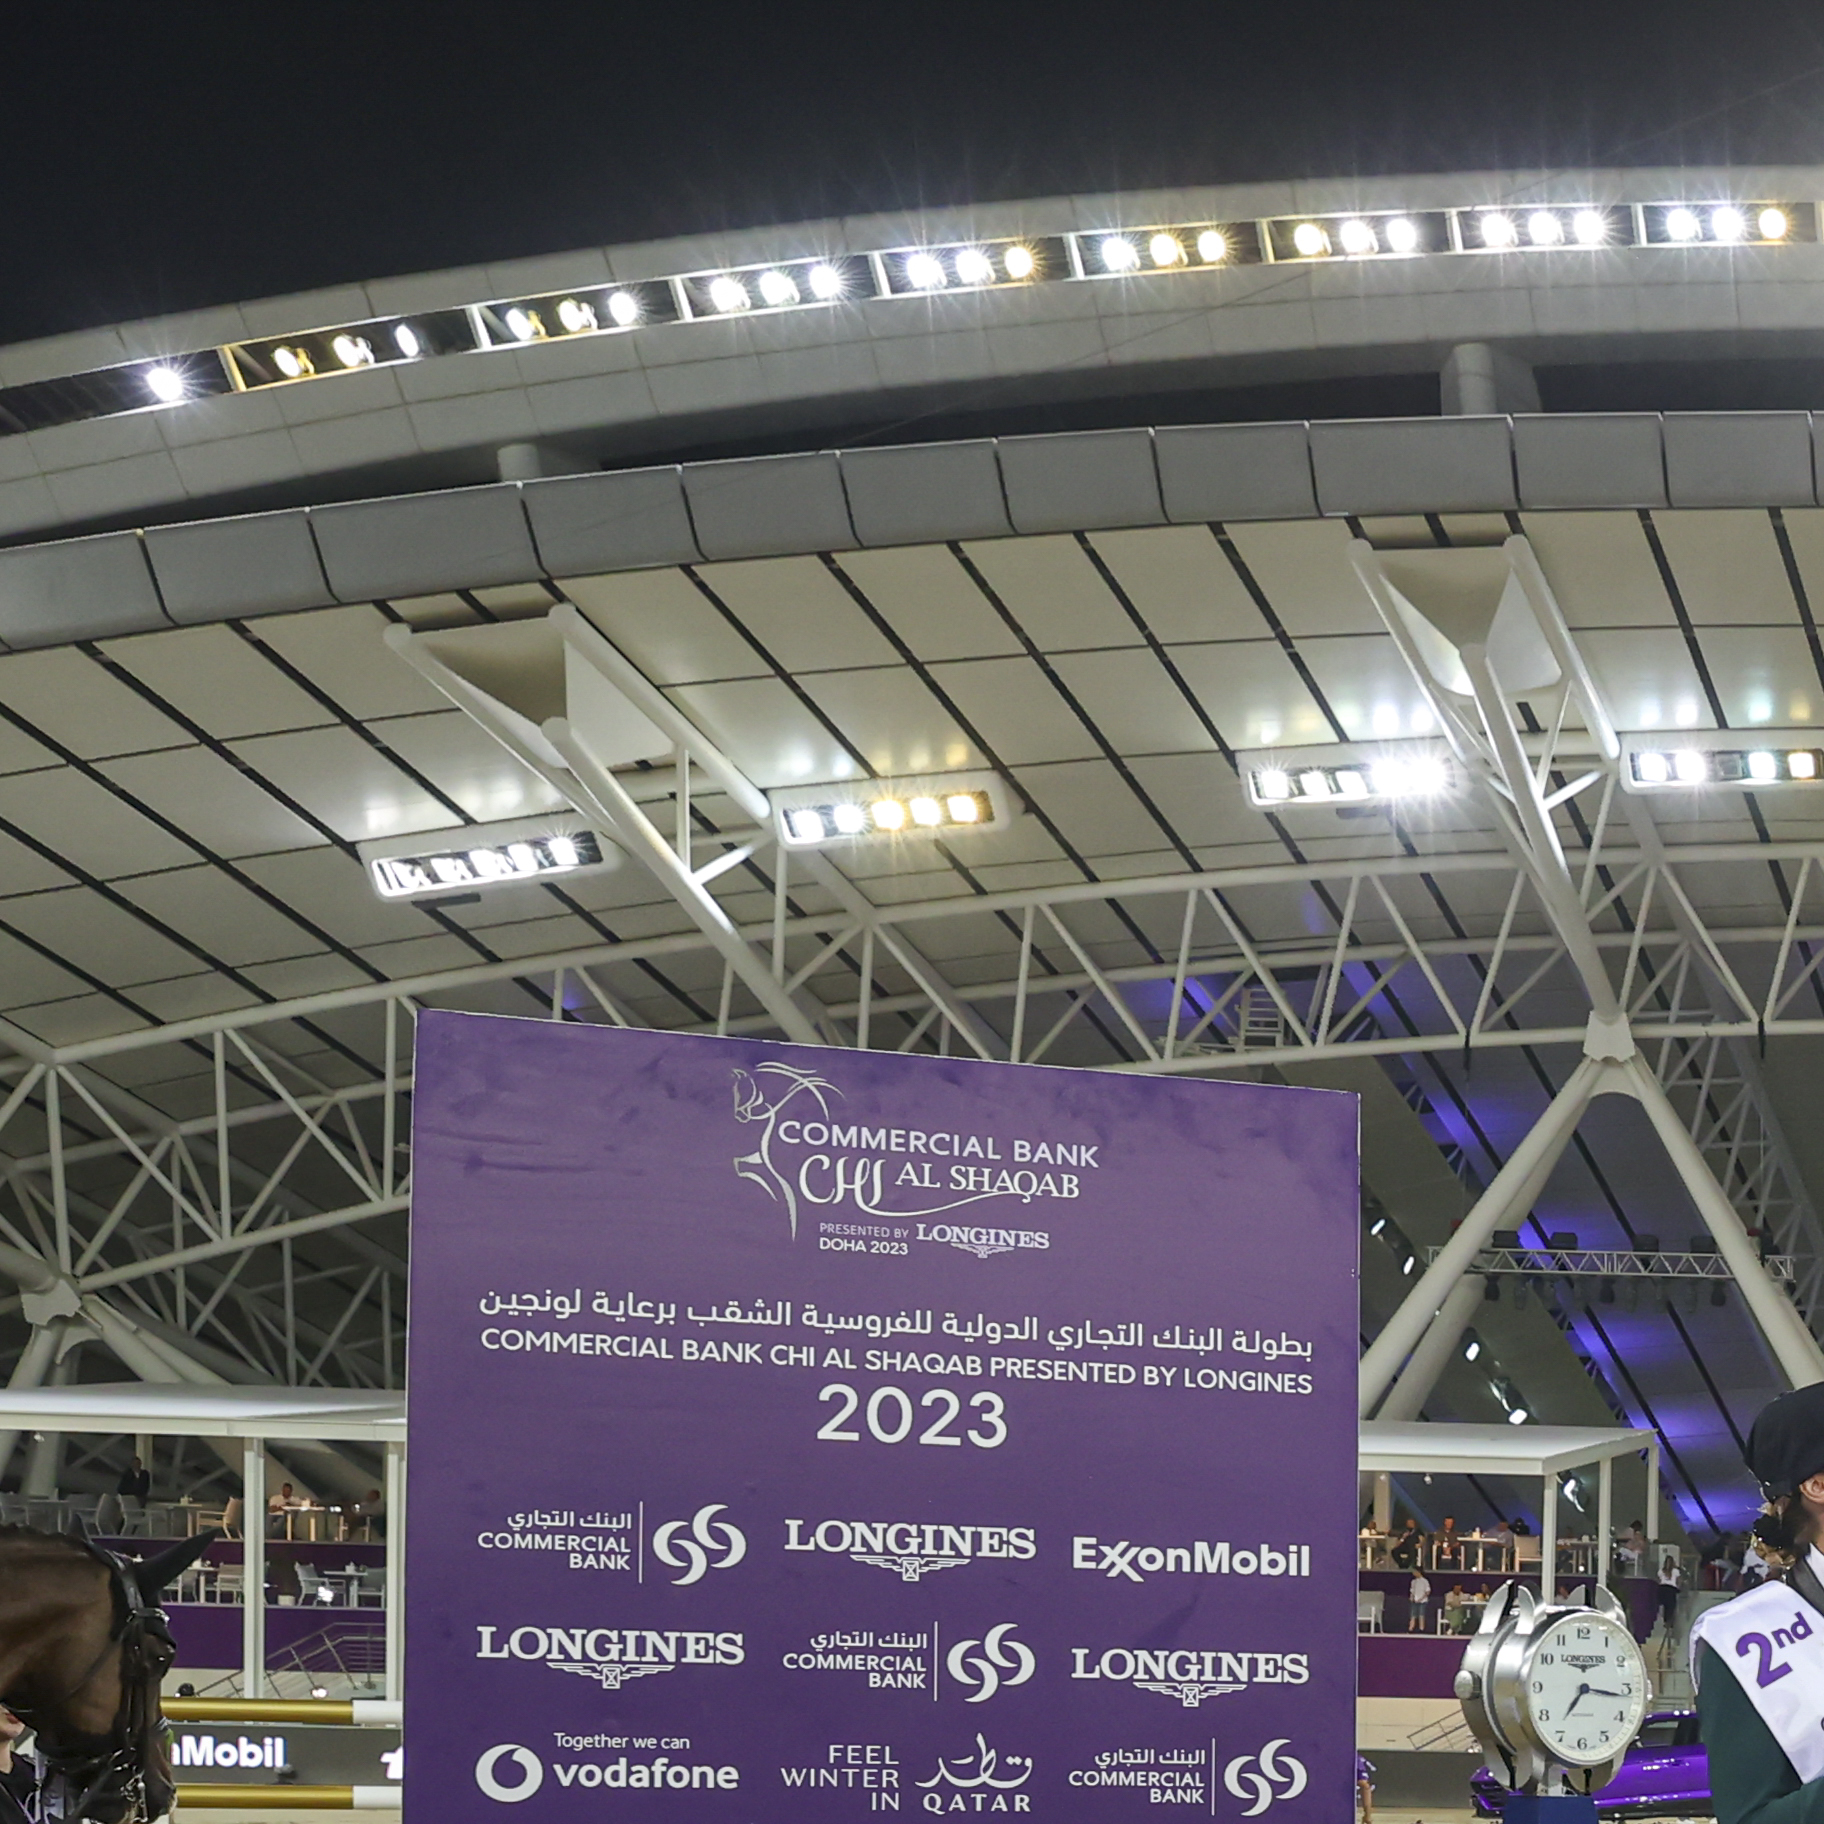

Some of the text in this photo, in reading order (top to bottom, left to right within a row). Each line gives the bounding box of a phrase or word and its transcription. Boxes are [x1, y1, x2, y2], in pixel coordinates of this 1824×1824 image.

[779, 1121, 1098, 1167] COMMERCIAL BANK
[799, 1154, 1080, 1213] CHI AL SHAQAB
[820, 1223, 1050, 1248] PRESENTED BY LONGINES
[820, 1237, 908, 1255] DOHA 2023
[480, 1289, 1312, 1362] بطولة البنك التجاري الدولية للفروسية الشقب برعاية لونجين
[481, 1328, 1312, 1394] COMMERCIAL BANK CHI AL SHAQAB PRESENTED BY LONGINES
[817, 1384, 1007, 1448] 2023
[508, 1510, 631, 1532] البنك التجاري
[478, 1532, 631, 1552] COMMERCIAL
[784, 1519, 1036, 1561] LONGINES
[570, 1553, 630, 1570] BANK
[1073, 1537, 1310, 1583] ExxonMobil
[1557, 1635, 1566, 1646] 11
[1577, 1627, 1590, 1640] 12
[1604, 1636, 1608, 1648] 1
[1735, 1611, 1814, 1689] 2nd
[1540, 1653, 1554, 1665] 10
[1560, 1654, 1606, 1664] LONGINES
[1616, 1656, 1626, 1668] 2
[1532, 1681, 1543, 1694] 9
[1621, 1683, 1632, 1696] 3
[1539, 1709, 1550, 1722] 8
[1613, 1710, 1624, 1722] 4
[1555, 1730, 1565, 1743] 7
[1577, 1737, 1588, 1750] 6
[1598, 1730, 1610, 1743] 5
